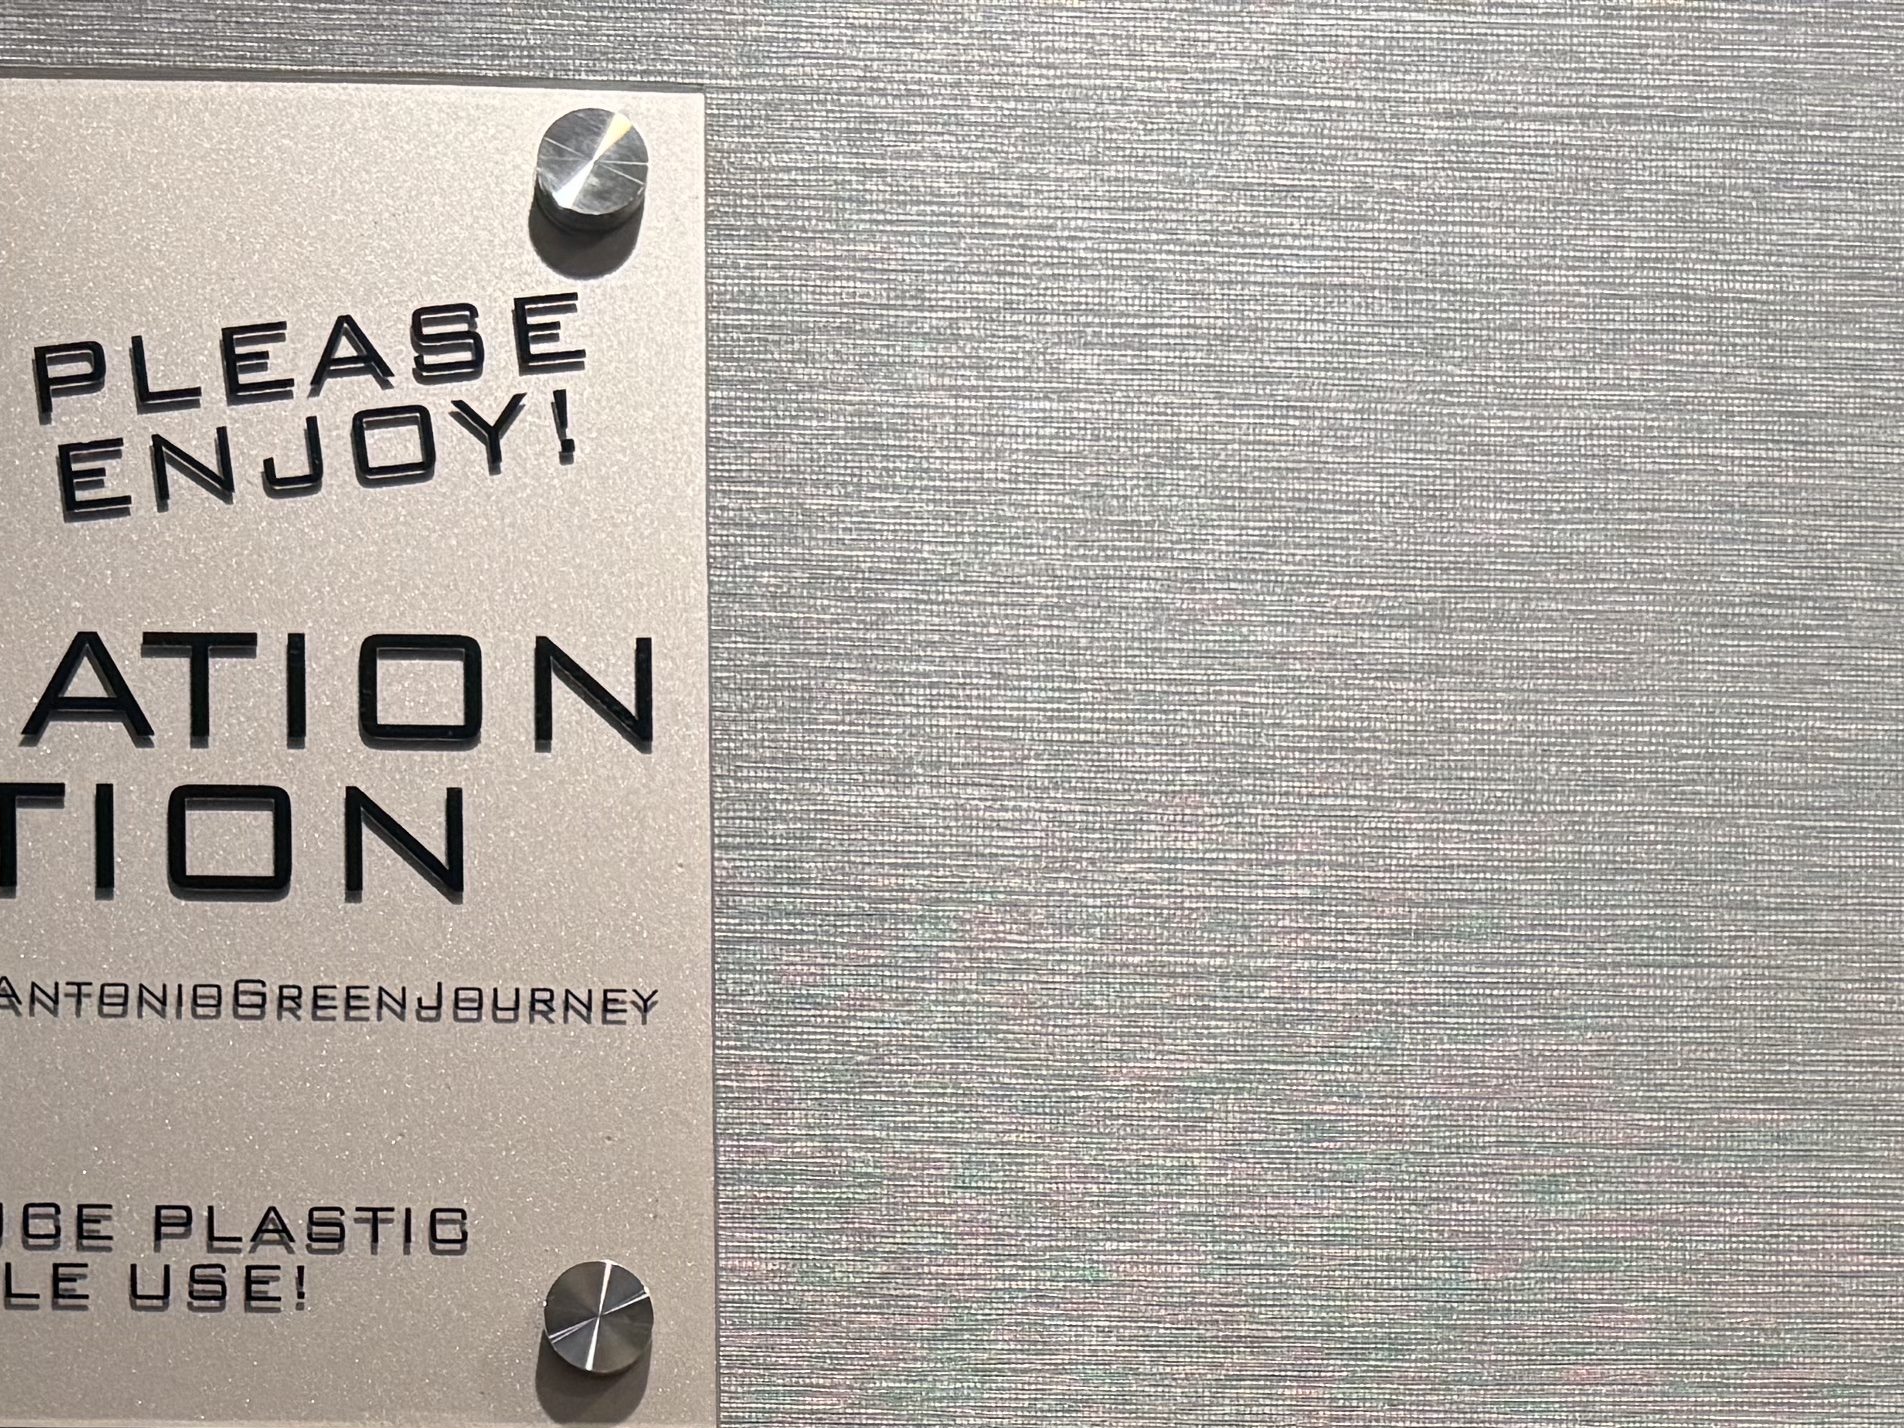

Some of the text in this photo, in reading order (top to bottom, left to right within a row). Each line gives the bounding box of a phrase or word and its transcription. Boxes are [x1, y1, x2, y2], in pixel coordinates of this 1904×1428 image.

[33, 291, 586, 416] PLEASE
[59, 389, 575, 516] ENJOY!
[154, 1205, 469, 1246] PLASTIC
[130, 1262, 307, 1304] USE!
